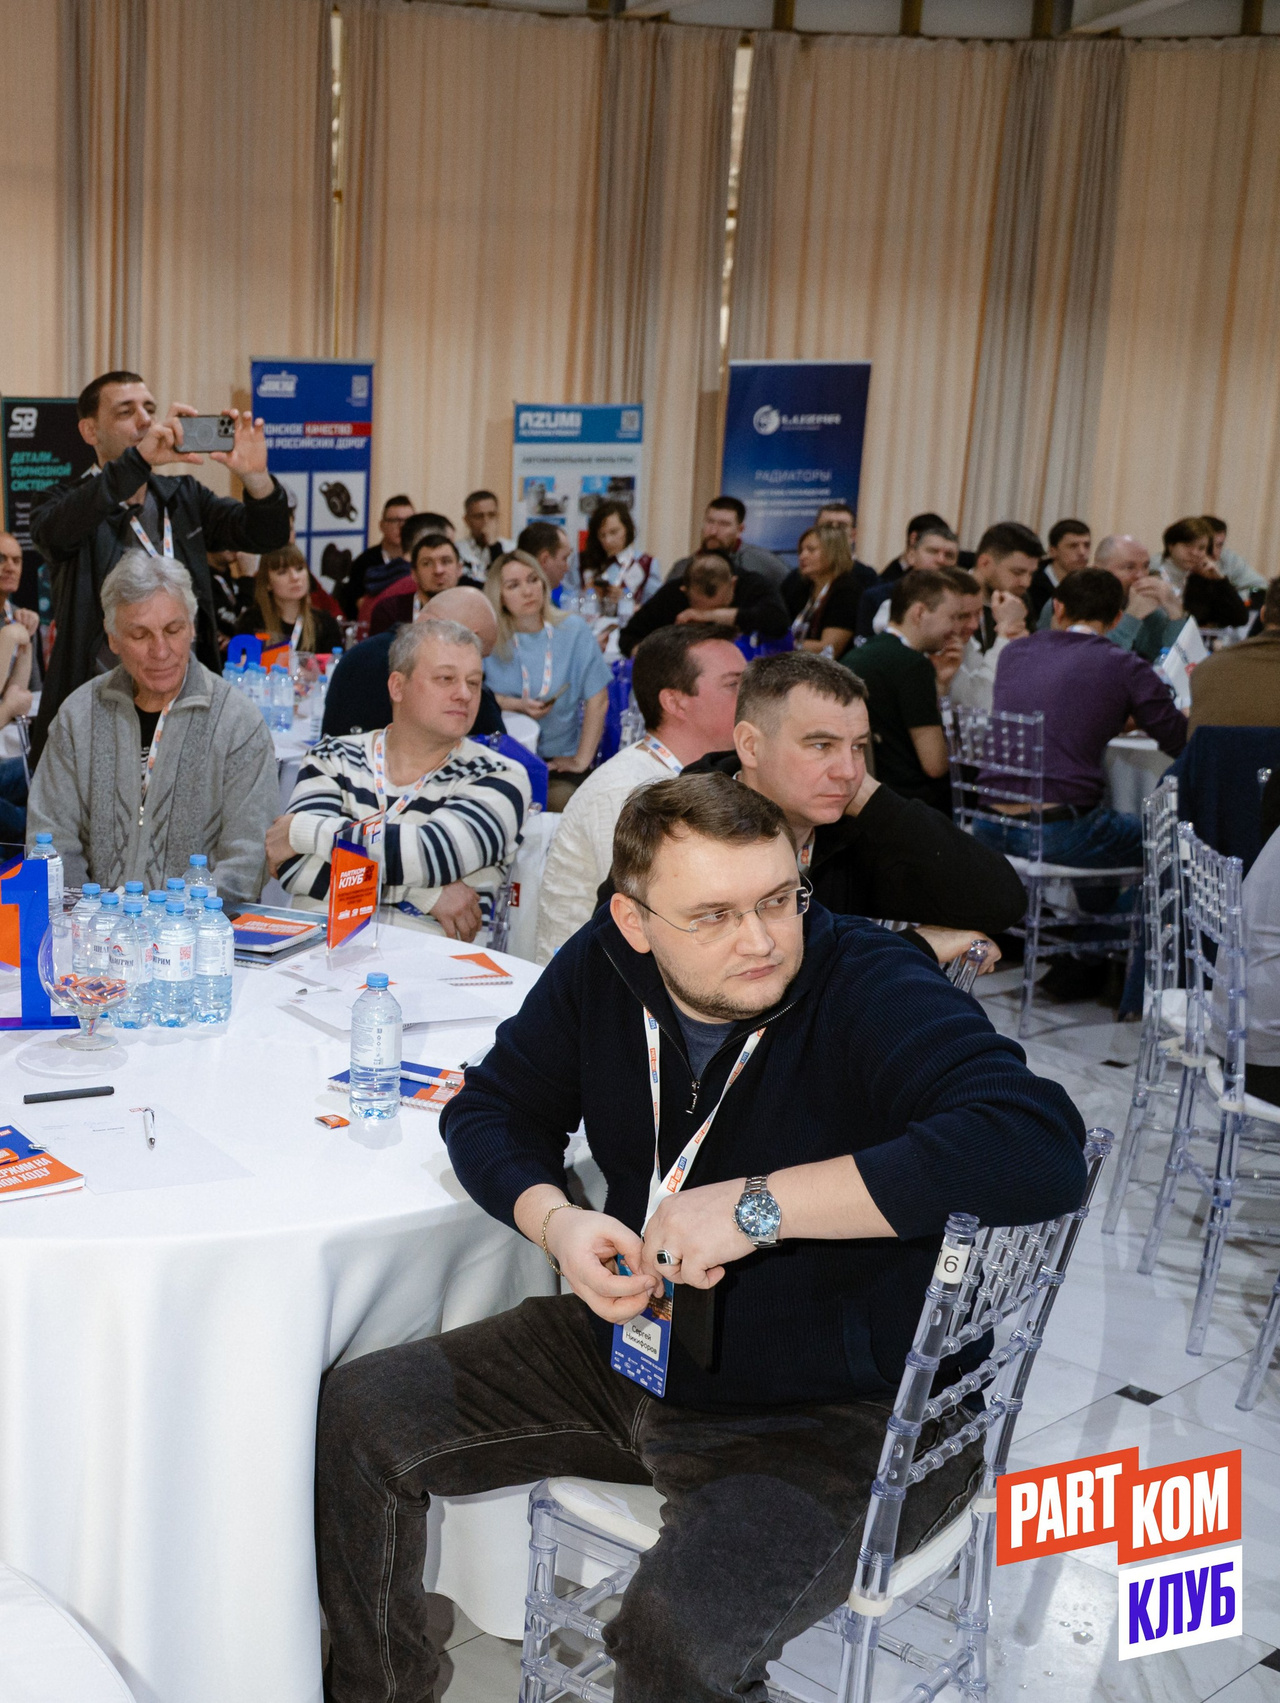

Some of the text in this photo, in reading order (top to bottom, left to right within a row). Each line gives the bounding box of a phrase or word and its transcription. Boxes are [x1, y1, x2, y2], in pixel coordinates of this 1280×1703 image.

[338, 873, 364, 889] КЛУБ
[33, 1157, 53, 1168] НА
[17, 1167, 51, 1183] ХОДУ
[631, 1324, 652, 1341] Сергей
[625, 1331, 657, 1355] Никифоров
